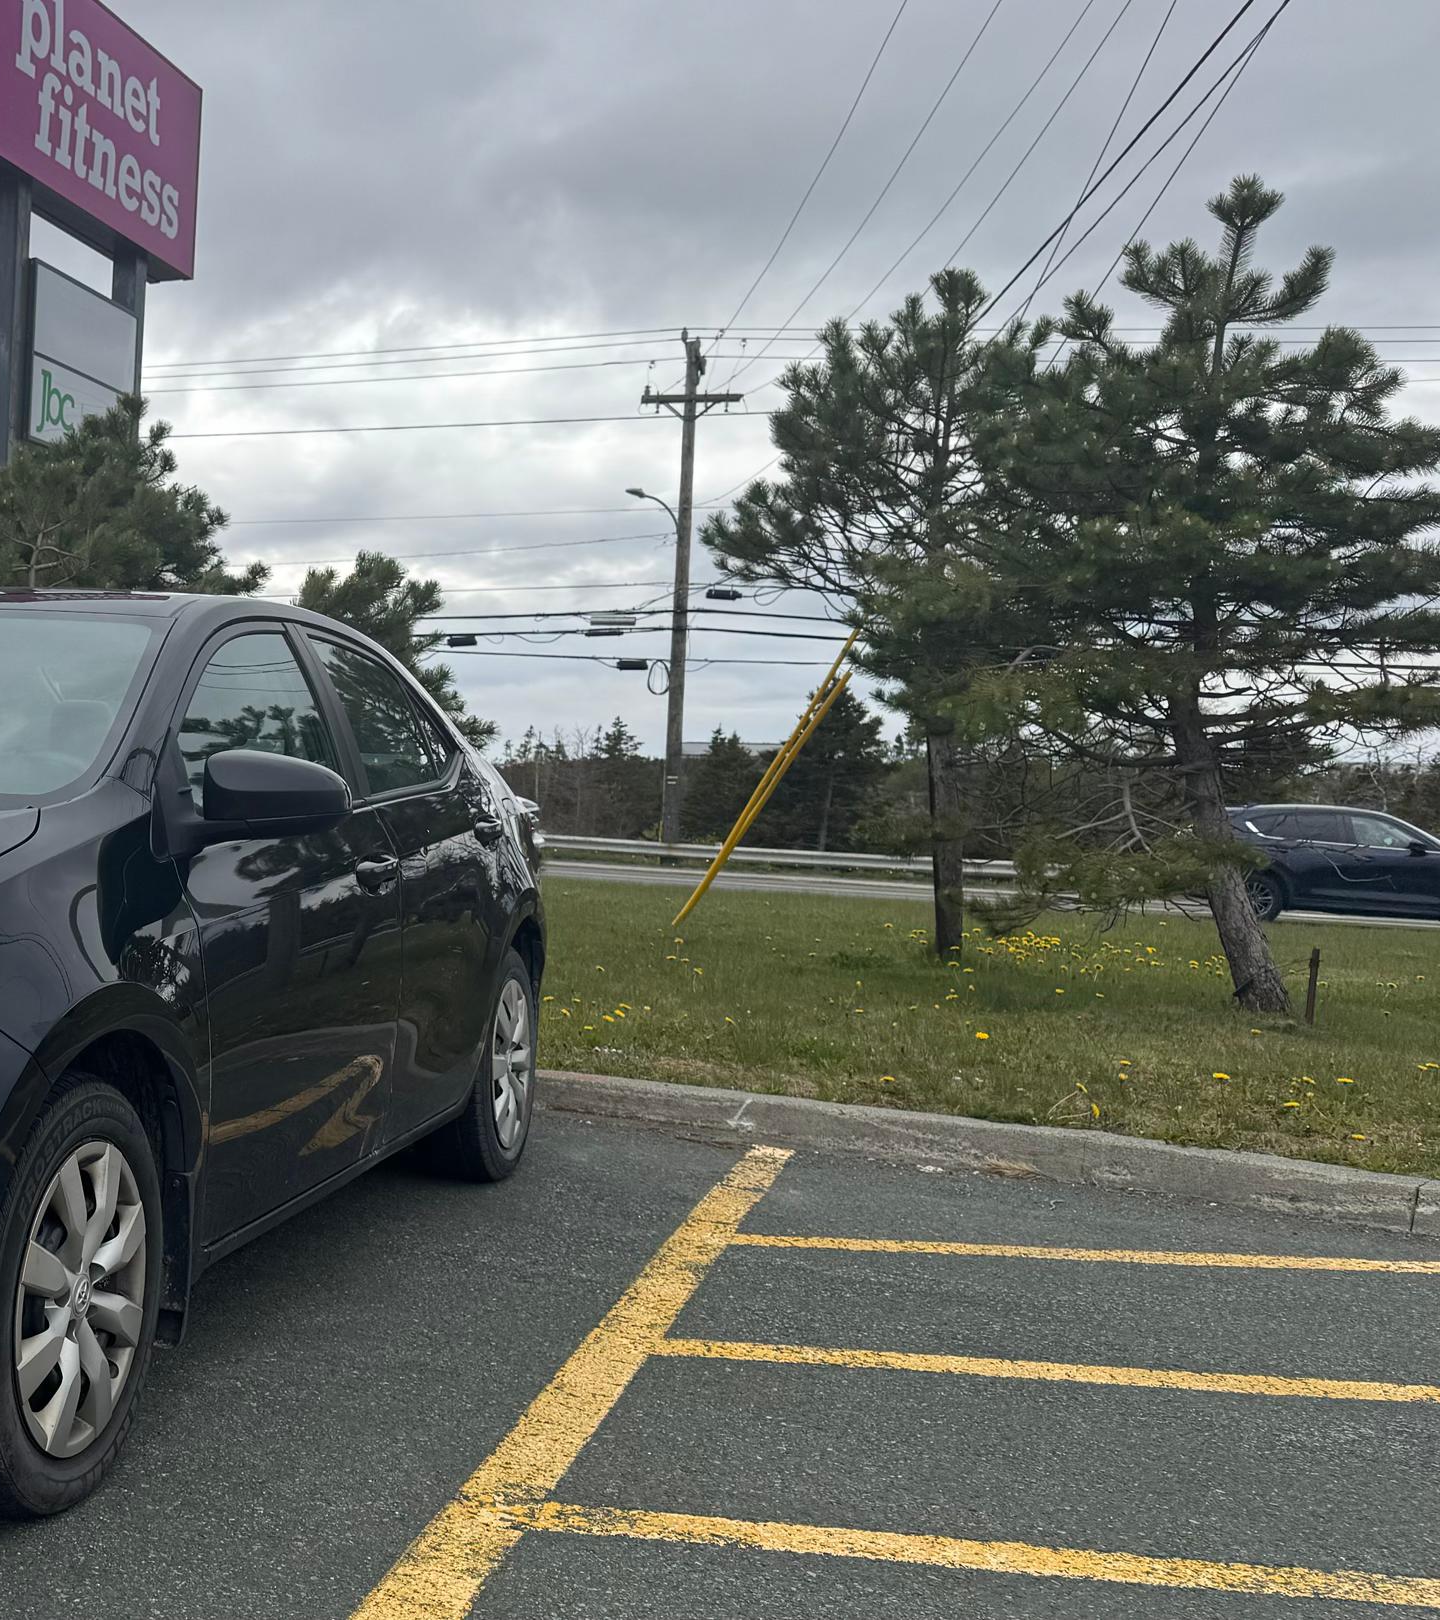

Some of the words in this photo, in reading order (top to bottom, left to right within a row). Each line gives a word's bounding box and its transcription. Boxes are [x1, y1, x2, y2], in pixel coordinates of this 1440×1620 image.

[16, 0, 161, 147] planet
[34, 72, 180, 240] fitness
[18, 1098, 102, 1222] FROSTRACK
